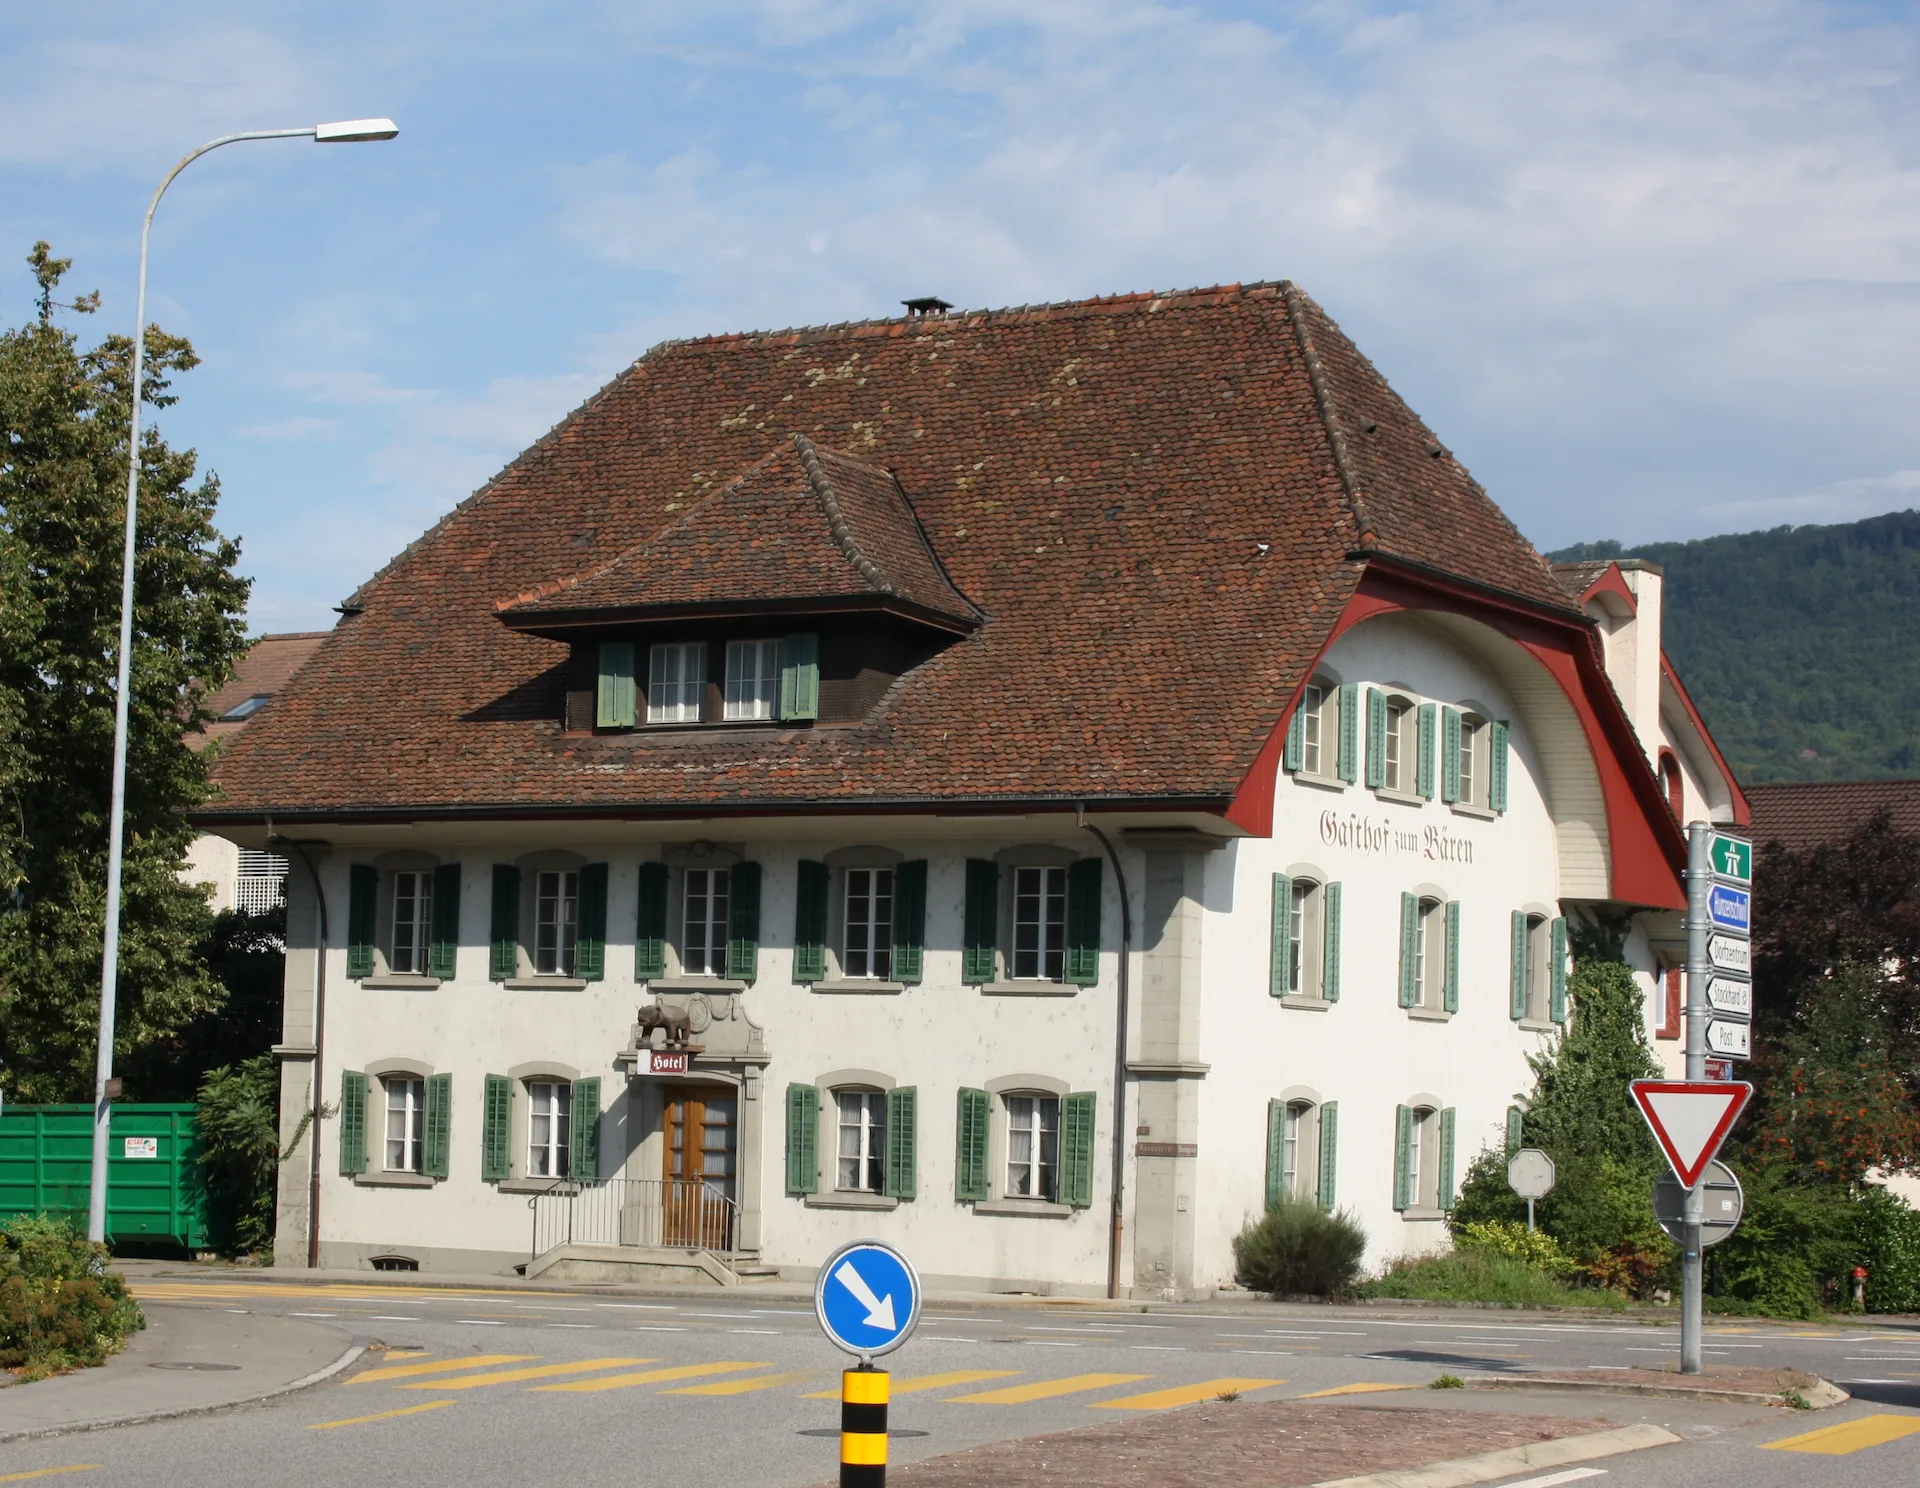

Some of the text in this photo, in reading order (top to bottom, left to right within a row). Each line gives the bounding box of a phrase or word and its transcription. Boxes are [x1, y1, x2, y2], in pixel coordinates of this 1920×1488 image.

[1394, 830, 1418, 854] zum
[1424, 825, 1473, 864] Bären
[1714, 891, 1748, 922] Hunzenschwil
[1714, 940, 1748, 964] Dorfzentrum
[1714, 984, 1740, 1006] Stockhard
[1719, 1027, 1733, 1047] Post
[653, 1055, 683, 1070] Hotel
